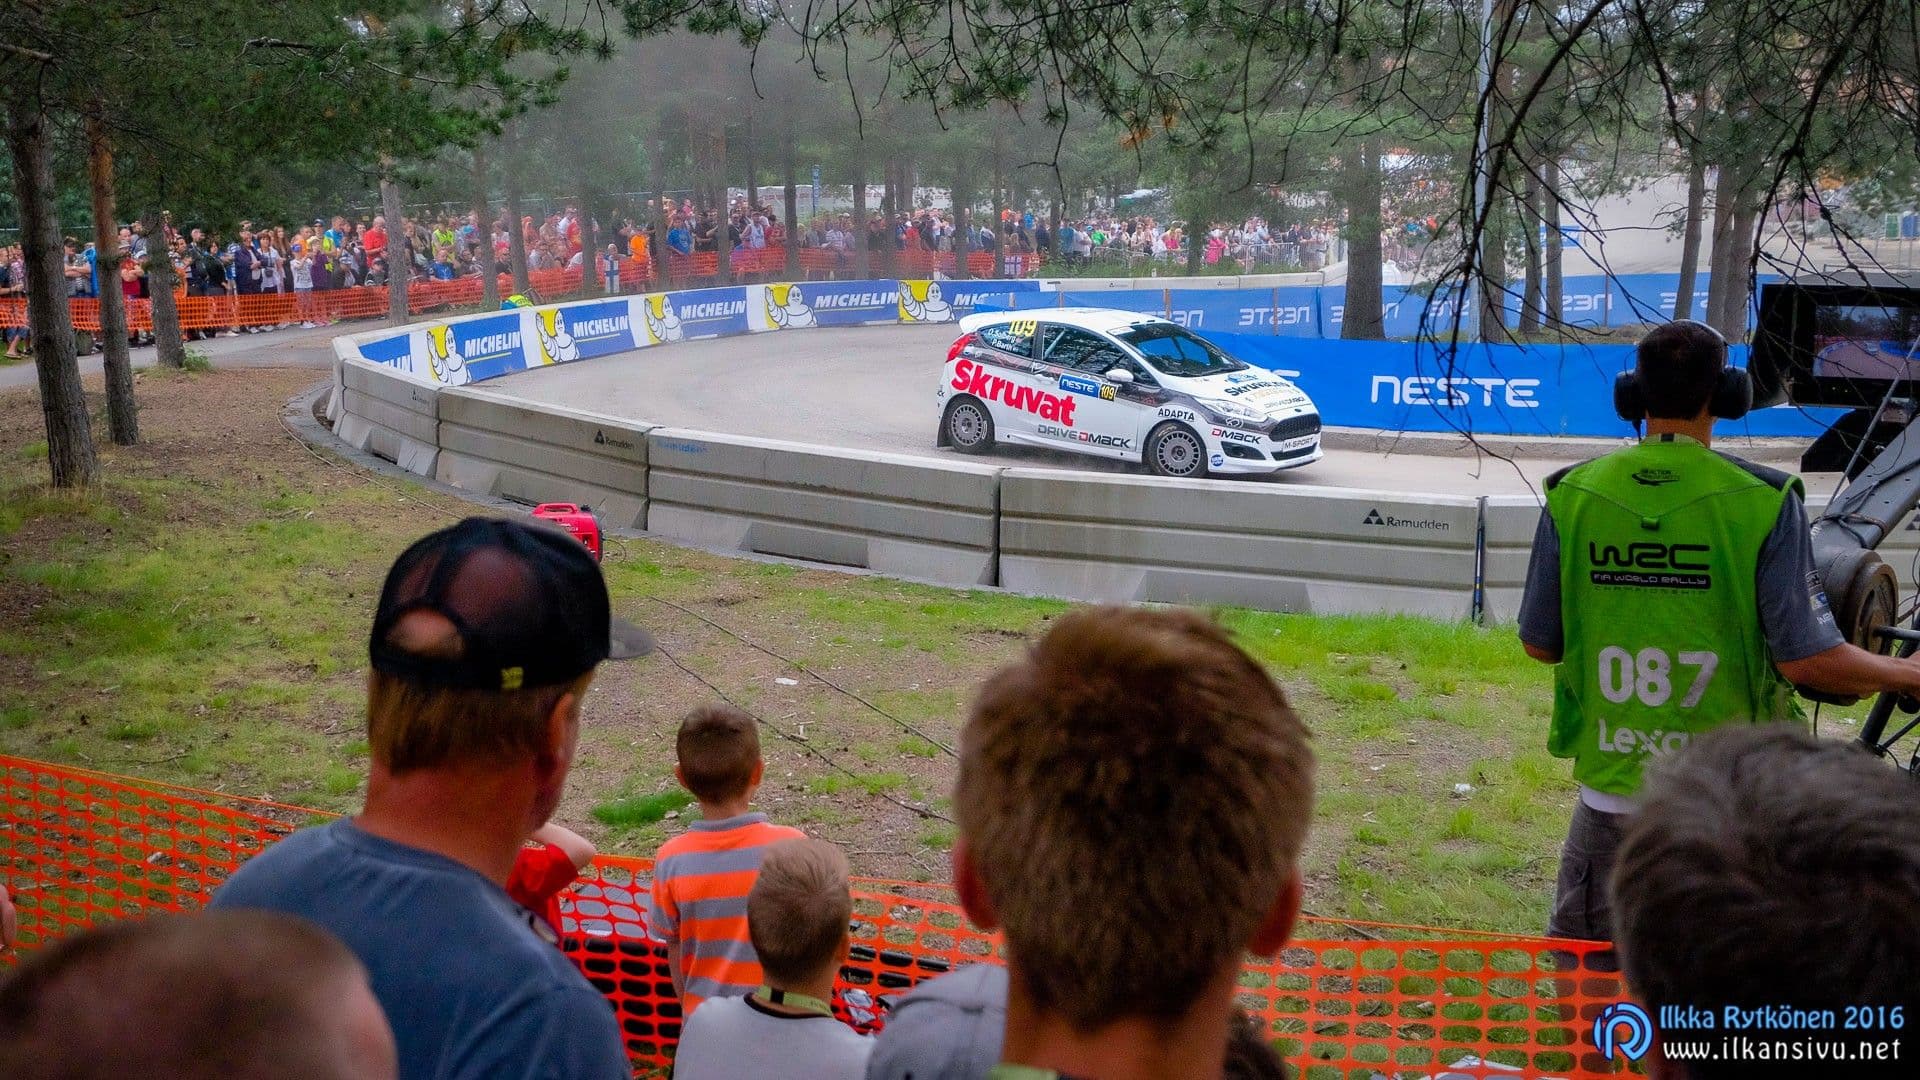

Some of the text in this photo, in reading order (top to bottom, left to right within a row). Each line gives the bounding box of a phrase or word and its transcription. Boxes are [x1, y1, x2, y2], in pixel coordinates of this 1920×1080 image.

[680, 300, 746, 317] MICHELIN
[814, 291, 898, 307] MICHELIN
[573, 315, 629, 338] MICHELIN
[1008, 319, 1038, 337] 109
[464, 331, 521, 358] MICHELIN
[951, 358, 1077, 427] Skruvat
[1061, 378, 1115, 400] NESTE 109
[1371, 375, 1541, 408] NESTE
[1157, 407, 1195, 421] ADAPTA
[1211, 427, 1261, 445] DMACK
[1283, 437, 1313, 450] M-SPORT
[1386, 516, 1450, 531] Ramudden
[1589, 541, 1711, 571] WRC
[1593, 573, 1707, 586] FIA WORLD RALLY
[1598, 645, 1719, 708] 087
[1598, 717, 1690, 756] Lexa
